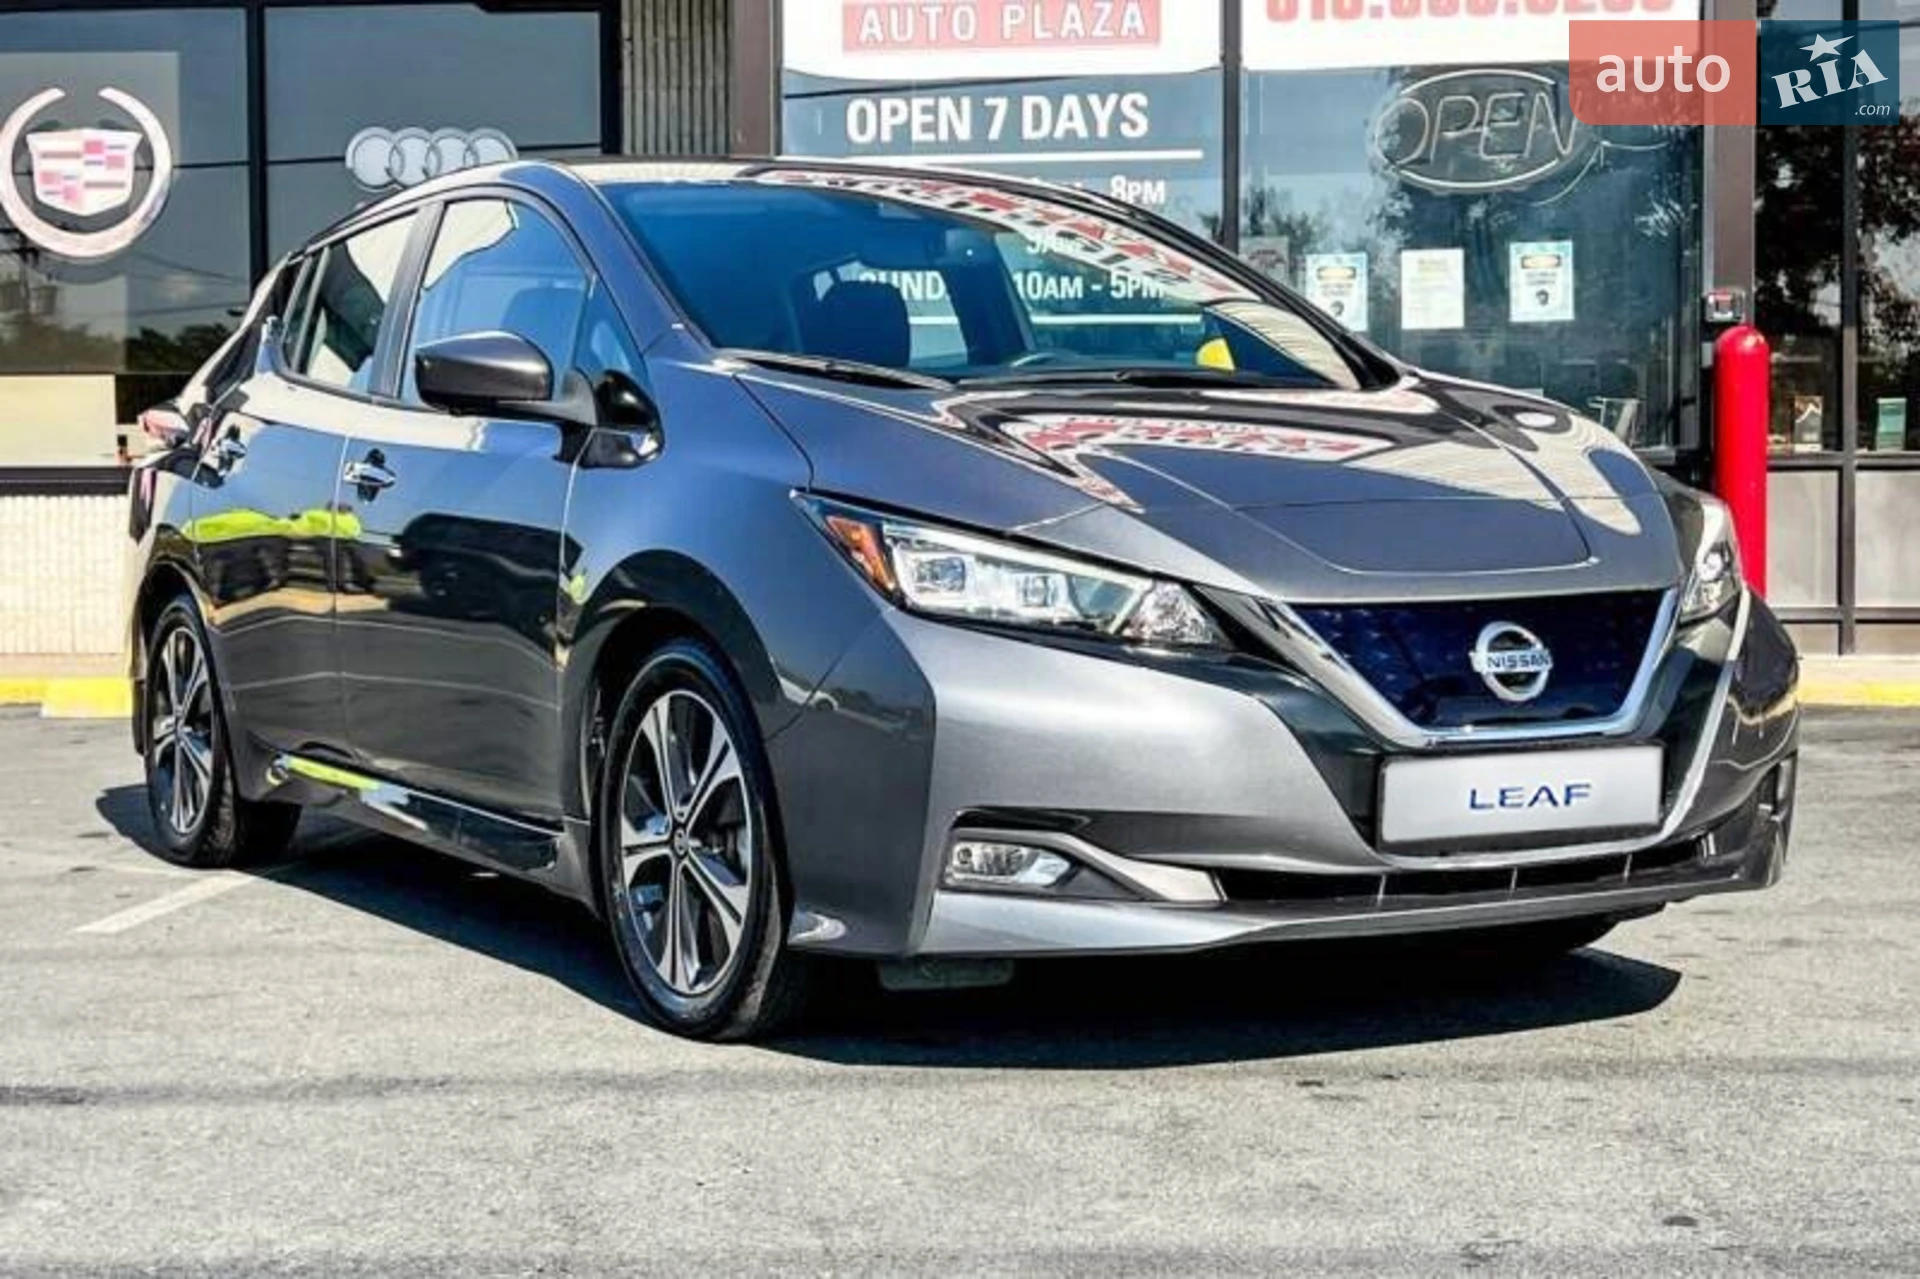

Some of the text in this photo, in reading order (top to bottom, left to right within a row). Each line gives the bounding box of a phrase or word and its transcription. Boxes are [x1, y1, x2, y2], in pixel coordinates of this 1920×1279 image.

[857, 1, 1146, 43] AUTO PLAZA
[846, 92, 1149, 144] OPEN 7 DAYS
[1376, 90, 1580, 166] OPEN
[1110, 175, 1166, 204] 8PM
[1012, 271, 1083, 300] 10AM
[1110, 271, 1166, 300] 5PM
[1486, 650, 1549, 670] NISSAN
[1468, 783, 1592, 811] LEAF
